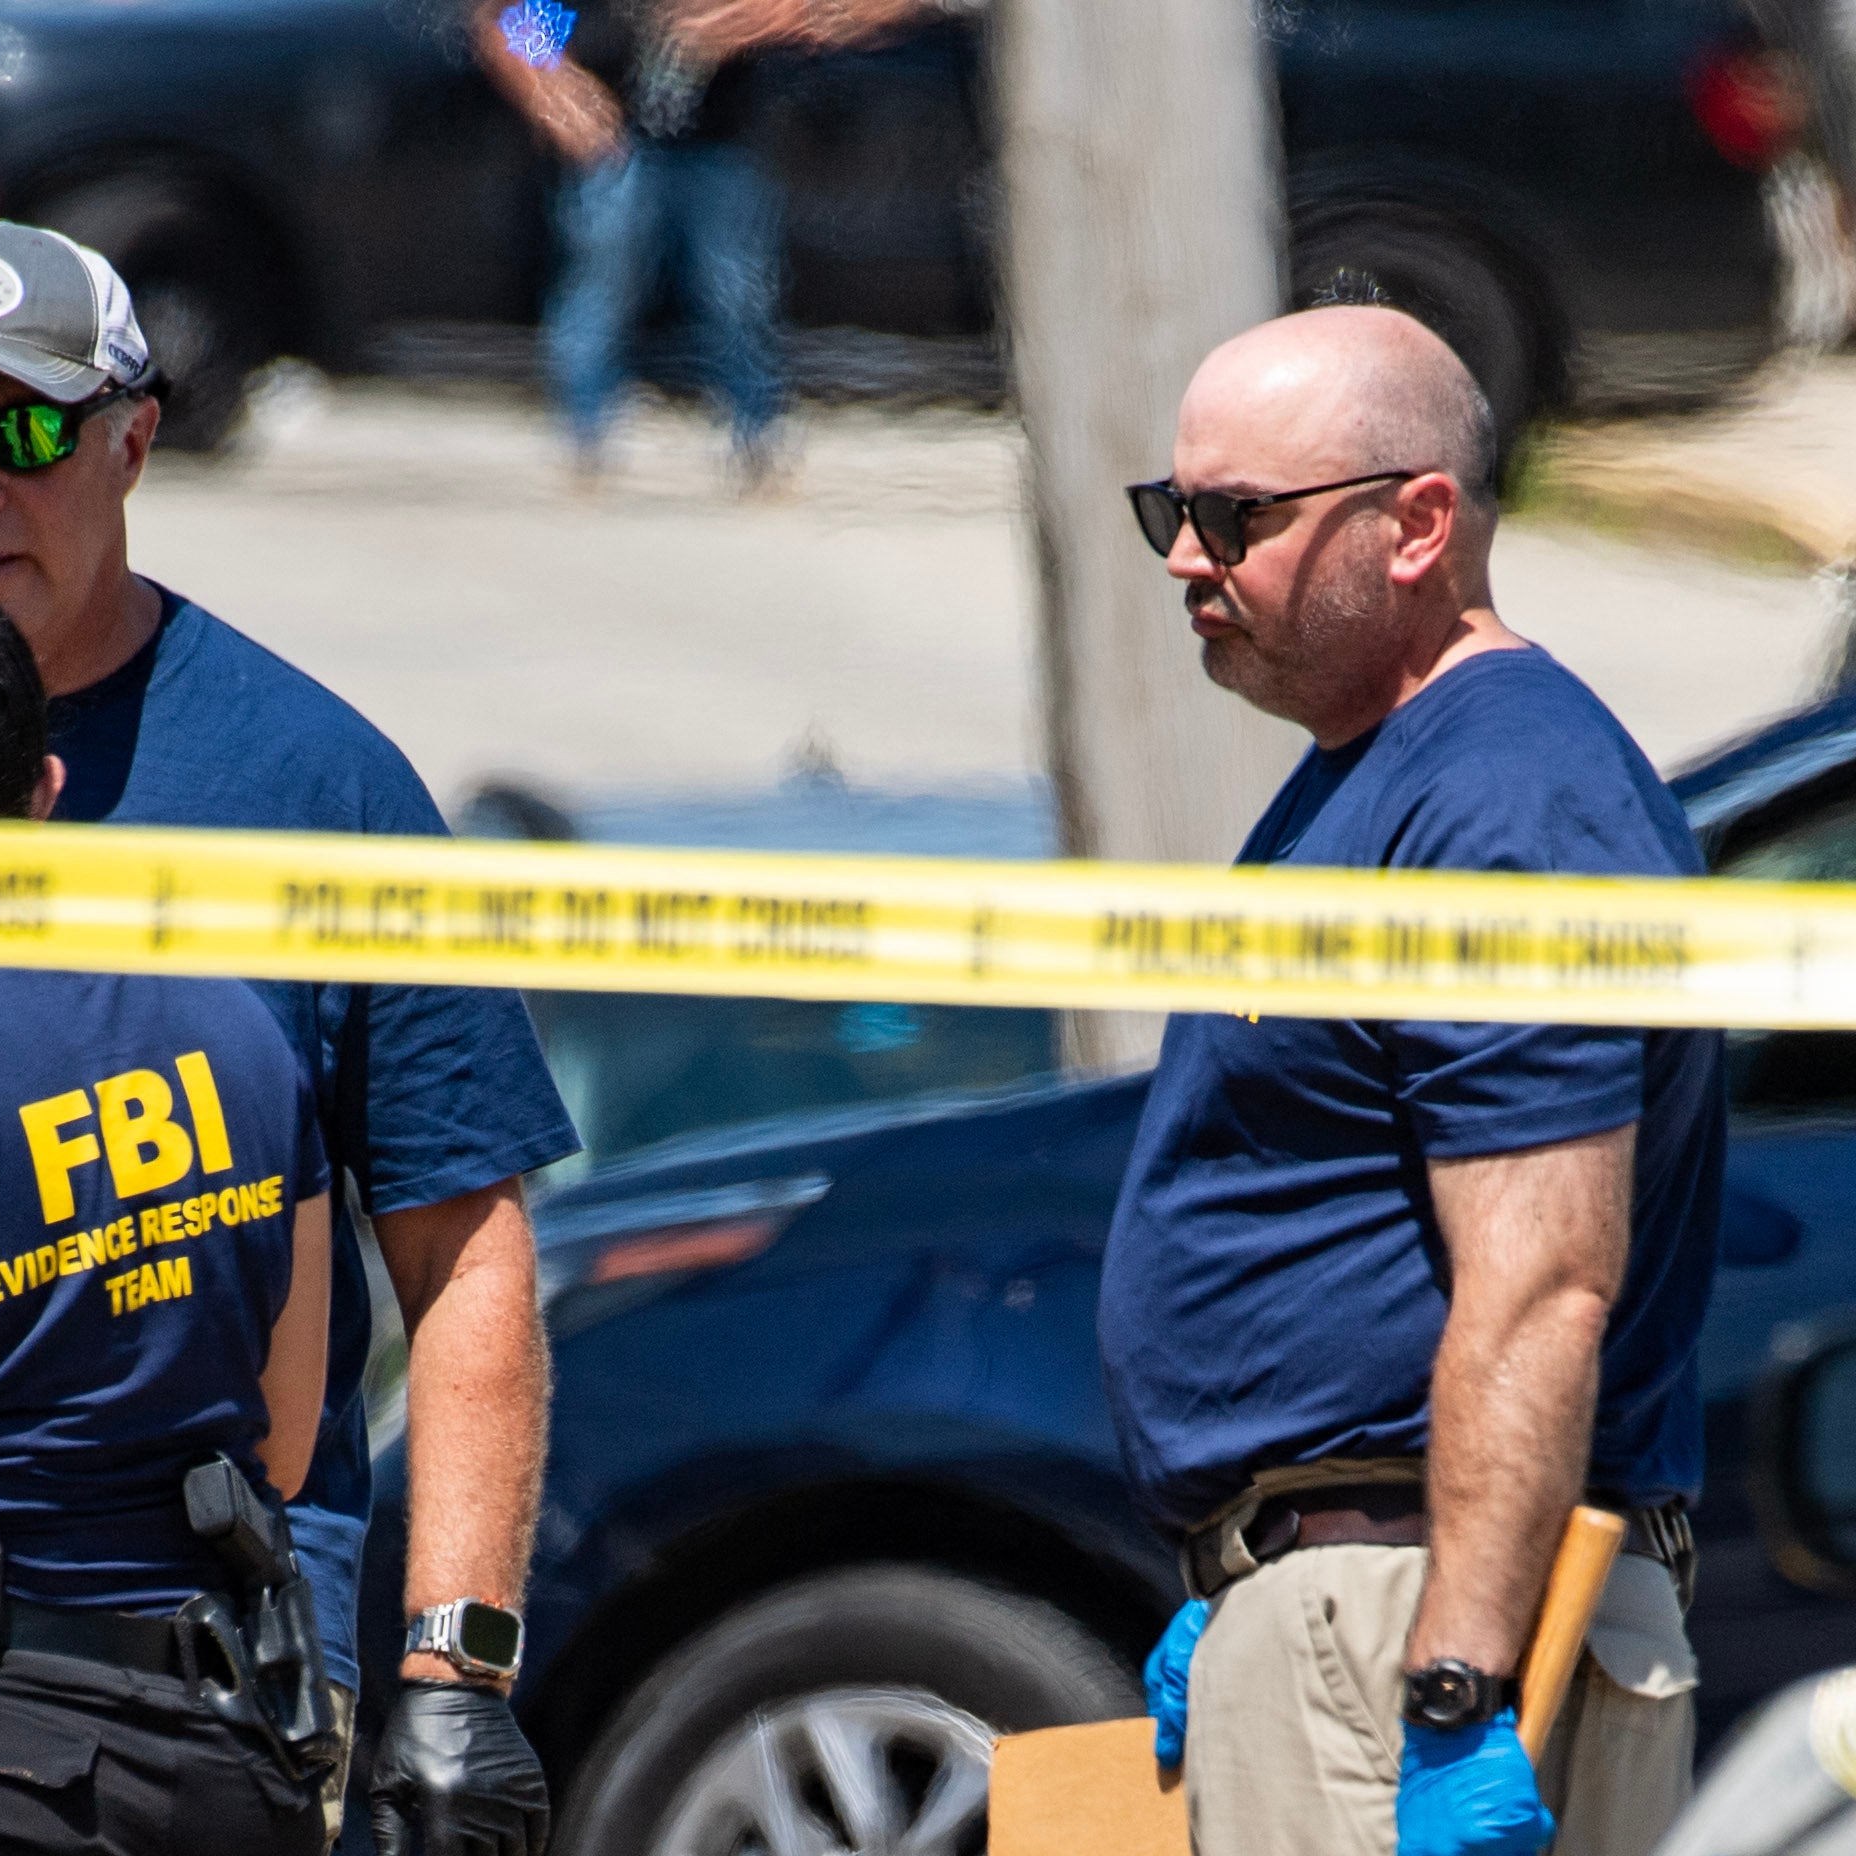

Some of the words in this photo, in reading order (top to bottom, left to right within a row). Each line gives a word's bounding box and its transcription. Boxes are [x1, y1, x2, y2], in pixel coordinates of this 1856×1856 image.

[276, 882, 429, 951] POLICE
[444, 887, 538, 956] LINE
[558, 888, 612, 957] DO
[633, 892, 714, 960] NOT
[733, 895, 869, 963] CROSS
[1098, 909, 1247, 982] POLICE
[1262, 912, 1356, 984] LINE
[1451, 914, 1528, 988] NOT
[1547, 916, 1688, 990] CROSS
[19, 1051, 233, 1225] FBI
[140, 1175, 284, 1248] RESPONSE
[105, 1256, 193, 1317] TEAM
